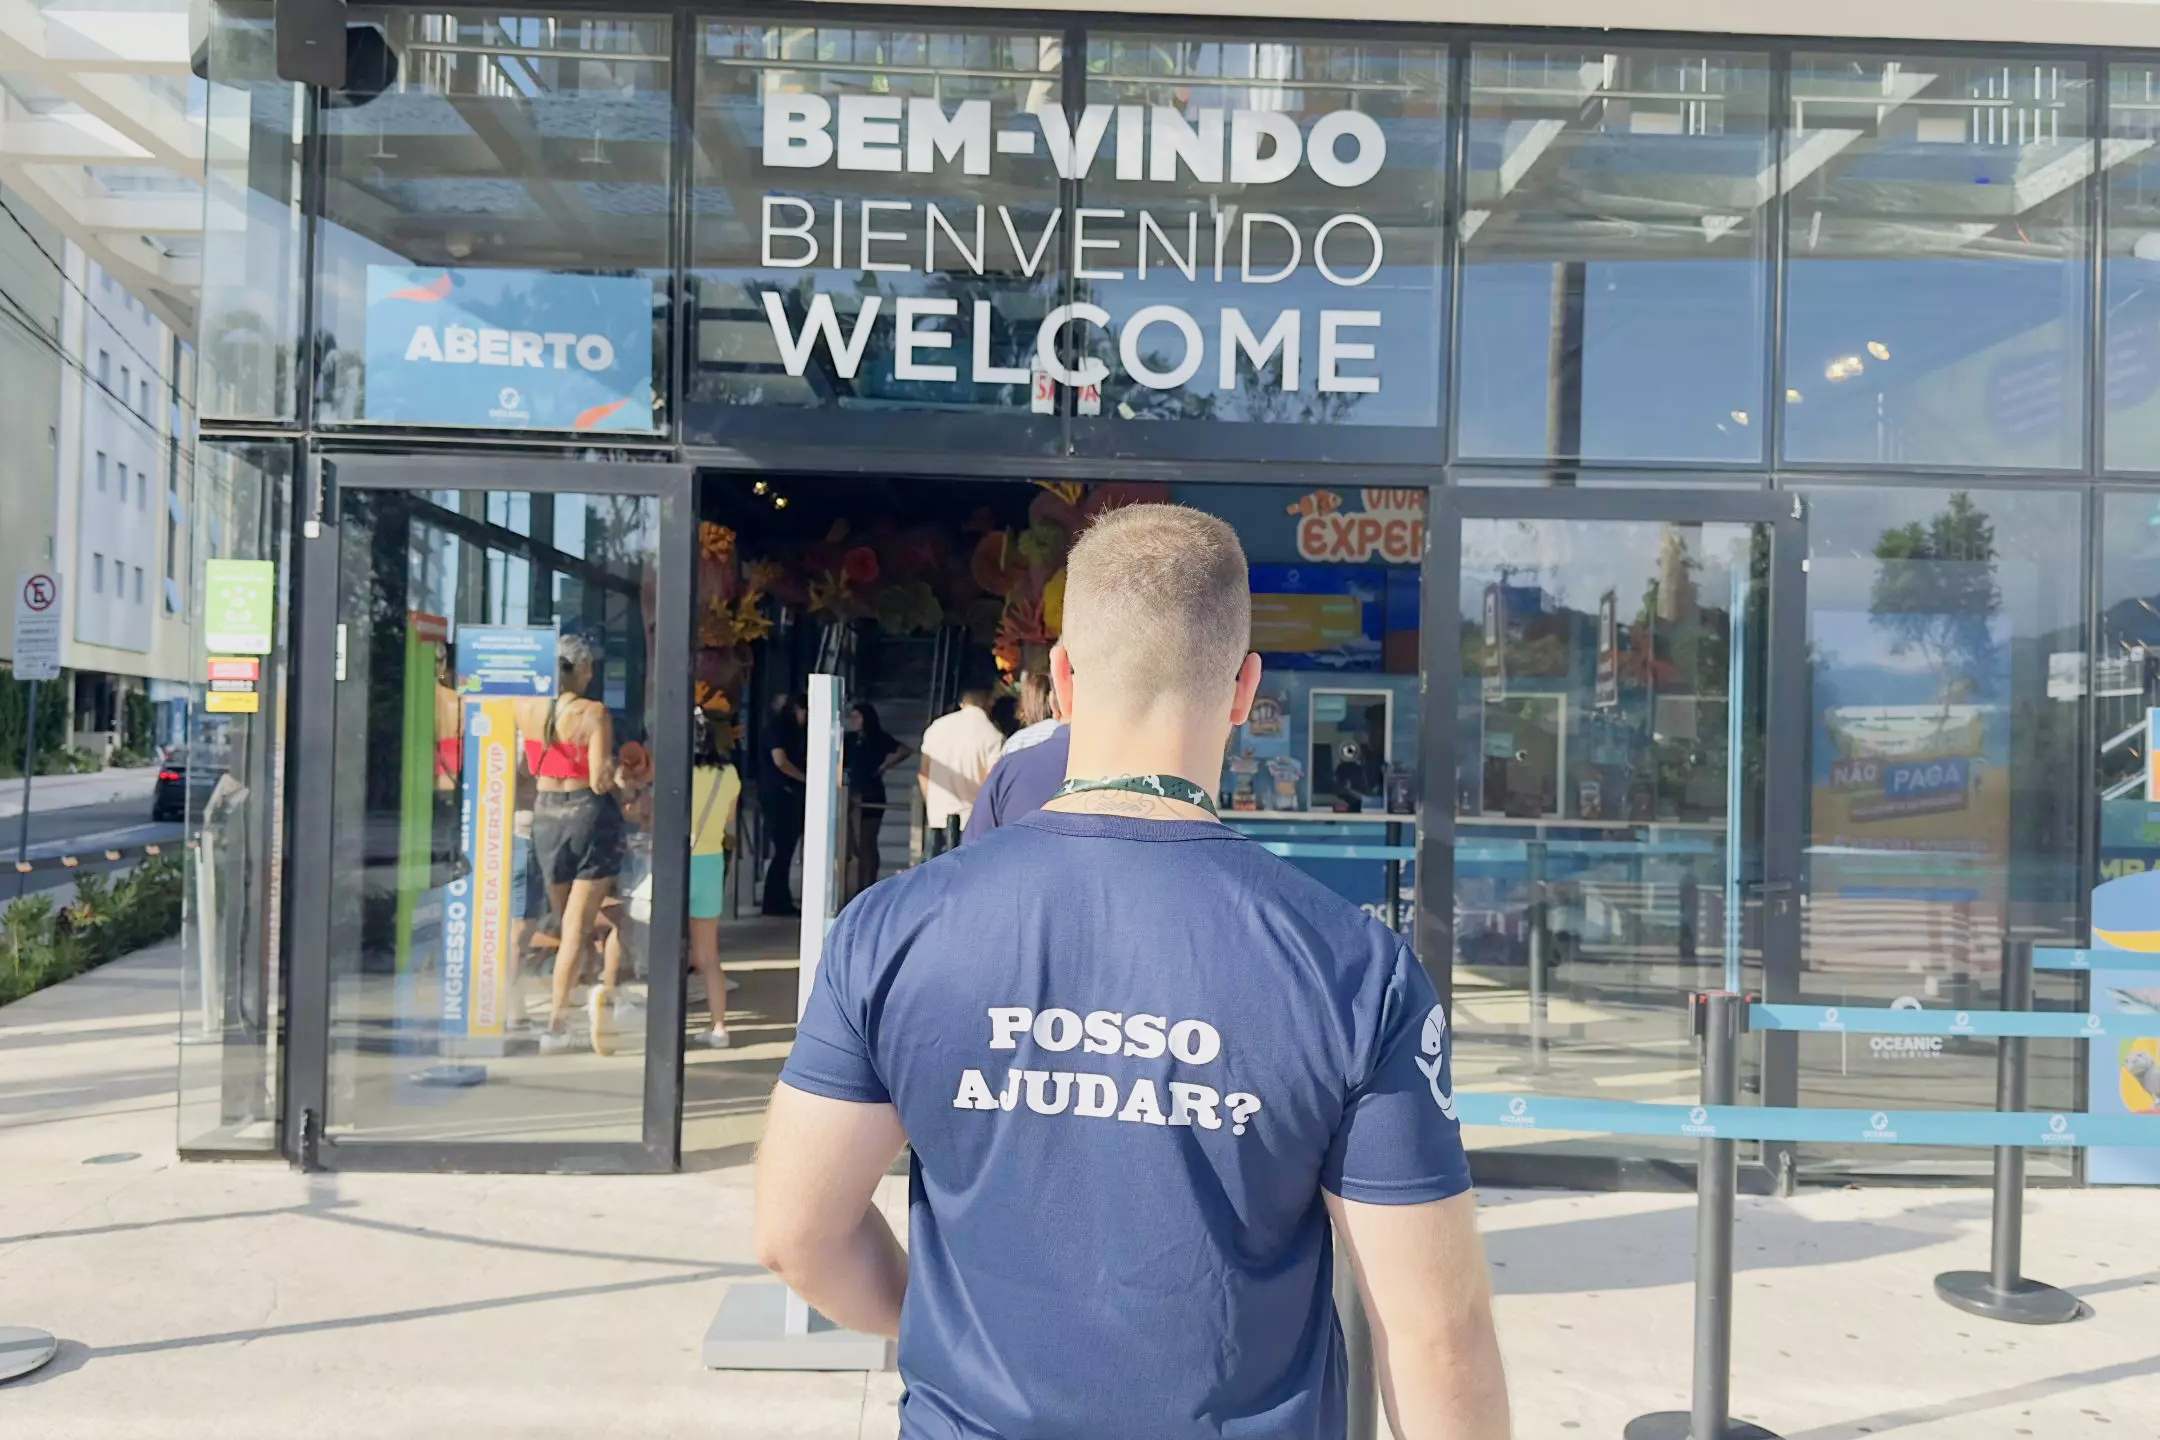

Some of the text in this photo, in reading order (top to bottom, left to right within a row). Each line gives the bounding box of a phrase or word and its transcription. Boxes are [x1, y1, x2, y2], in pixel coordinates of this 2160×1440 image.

[763, 93, 1387, 187] BEM-VINDO
[761, 196, 1384, 287] BIENVENIDO
[404, 324, 615, 372] ABERTO
[761, 291, 1382, 392] WELCOME
[1035, 372, 1098, 402] SAA
[480, 746, 505, 1025] PASSAPORTE DA DIVERSÃO VIP
[443, 902, 467, 1020] INGRESSO
[988, 1007, 1221, 1065] POSSO
[1870, 1036, 1944, 1051] OCEANIC
[953, 1068, 1262, 1136] AJUDAR?
